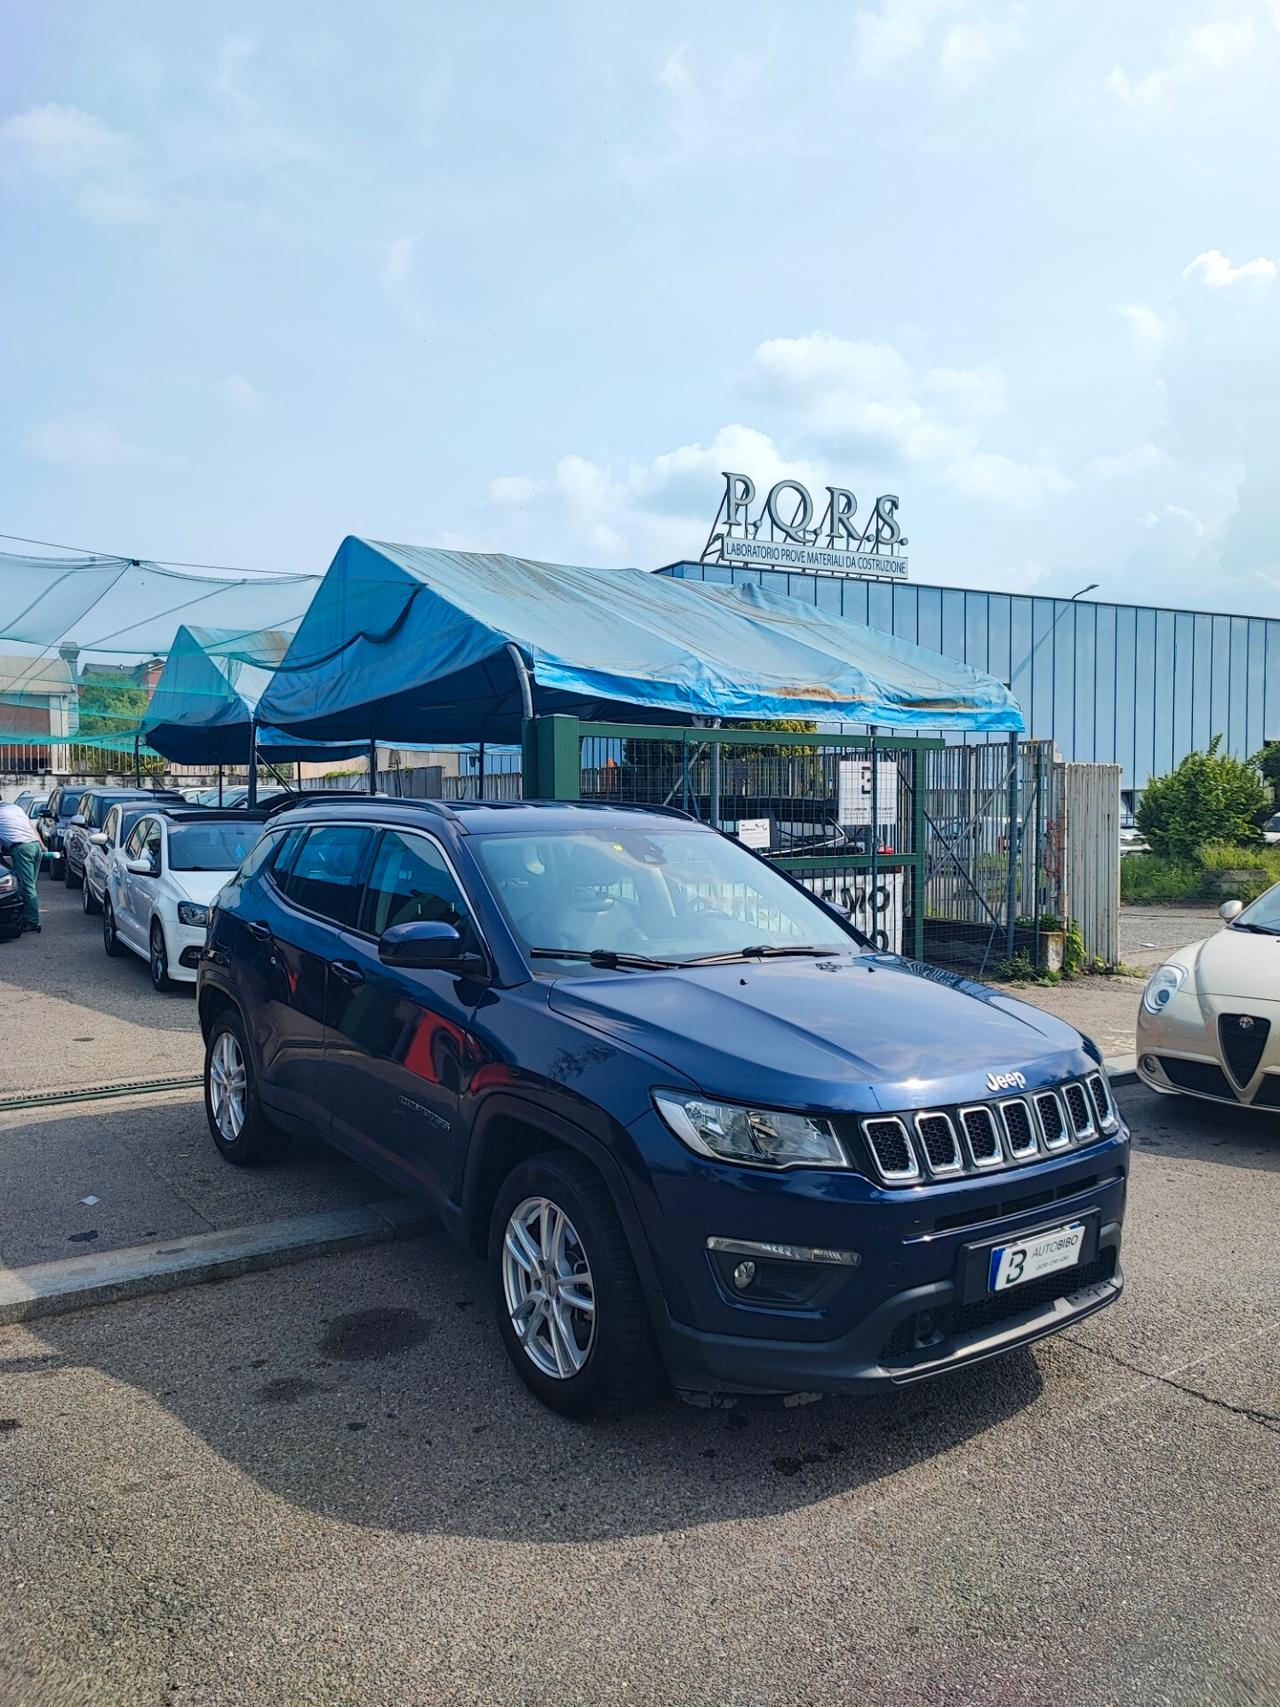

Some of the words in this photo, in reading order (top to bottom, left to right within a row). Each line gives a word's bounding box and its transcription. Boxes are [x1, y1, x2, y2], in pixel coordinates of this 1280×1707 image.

[726, 542, 780, 560] LABORATORIO
[781, 548, 806, 564] PROVE
[807, 551, 845, 568] MATERIALI
[845, 555, 857, 568] DA
[857, 557, 906, 574] COSTRUZIONE
[986, 1071, 1027, 1092] Jeep
[1031, 1234, 1079, 1259] AUTOBIBO
